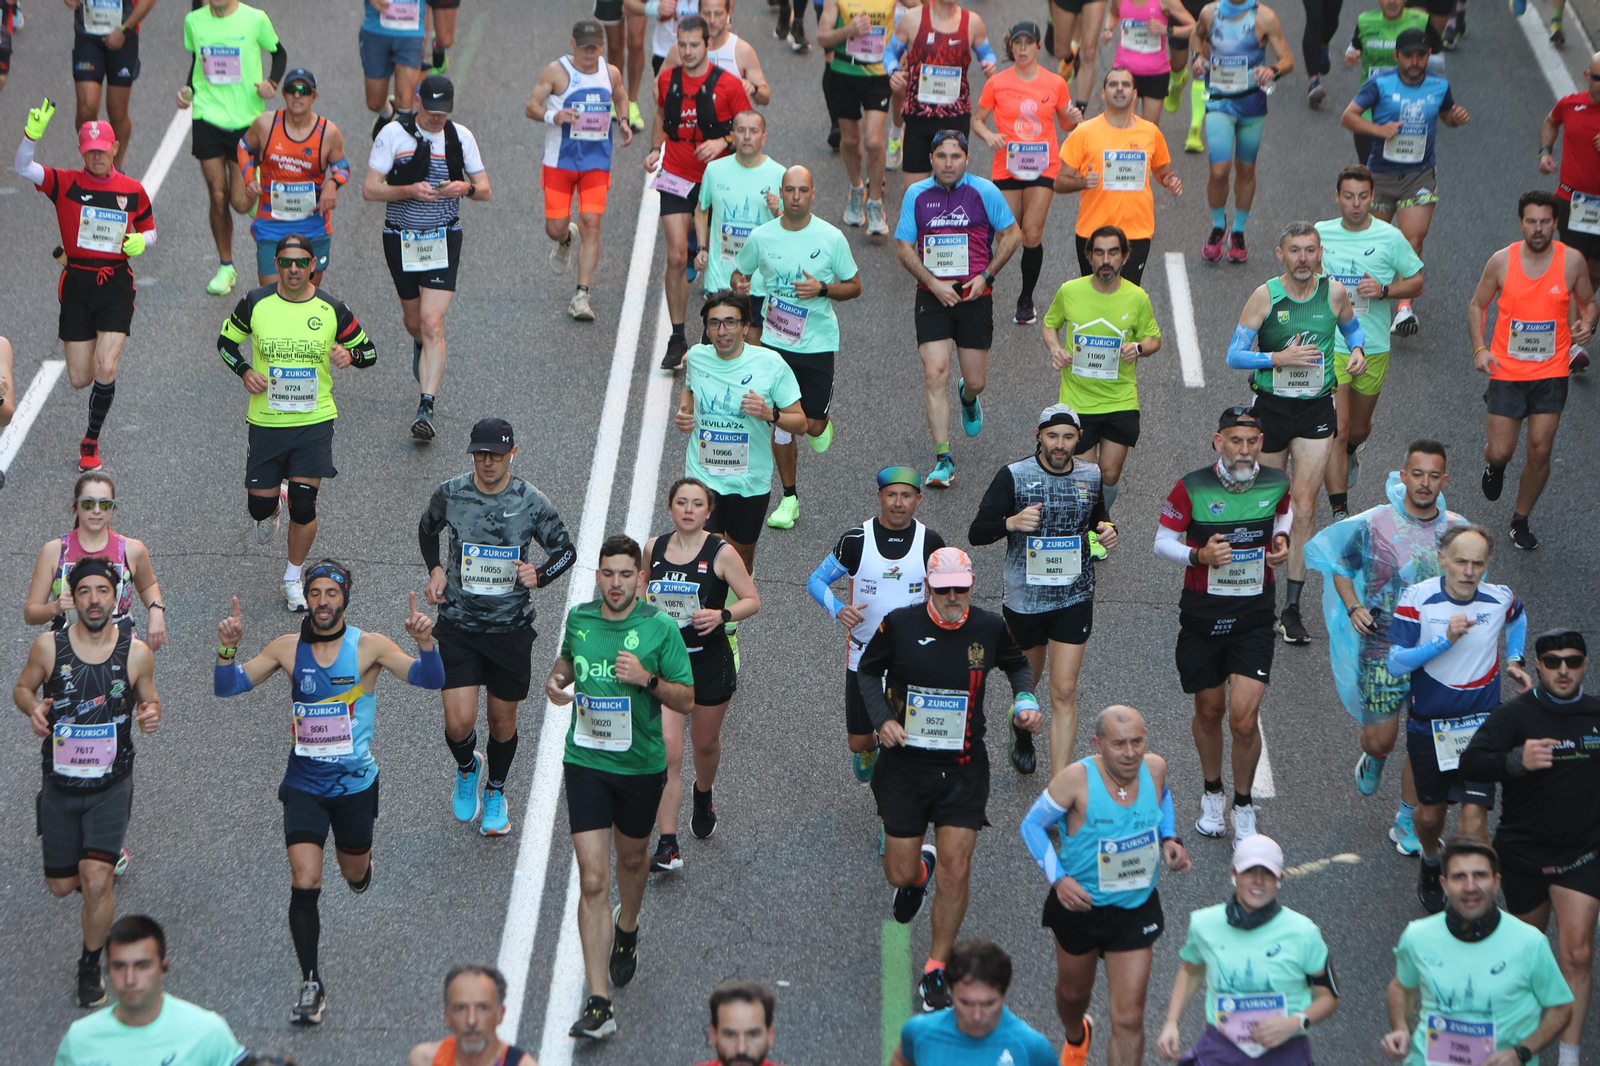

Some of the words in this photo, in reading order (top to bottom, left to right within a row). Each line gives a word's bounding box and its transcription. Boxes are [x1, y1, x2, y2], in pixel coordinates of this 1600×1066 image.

[269, 154, 313, 169] RUNNING
[98, 210, 123, 221] ZURICH
[417, 231, 440, 241] ZURICH
[937, 237, 962, 245] ZURICH
[416, 245, 433, 253] 10422
[779, 302, 803, 316] ZURICH
[776, 315, 789, 326] 7805
[1090, 339, 1115, 347] ZURICH
[275, 351, 293, 361] Night
[1087, 352, 1106, 361] 11069
[1289, 371, 1309, 379] 10057
[700, 419, 744, 430] SEVILLA'24
[714, 433, 744, 441] ZURICH
[712, 449, 732, 457] 10966
[704, 457, 741, 466] SALVATIERRA
[1046, 540, 1075, 548] ZURICH
[483, 549, 513, 558] ZURICH
[1231, 551, 1258, 561] ZURICH
[1046, 557, 1062, 565] 9481
[480, 565, 502, 574] 10055
[464, 575, 491, 583] ZAKARIA
[492, 576, 514, 584] BELHAJ
[1217, 577, 1257, 585] MANULOSETA
[664, 584, 691, 593] ZURICH
[664, 600, 684, 608] 10876
[1210, 629, 1231, 637] PORT
[77, 694, 106, 715] MRW
[591, 700, 622, 709] ZURICH
[928, 700, 959, 709] ZURICH
[308, 706, 341, 716] ZURICH
[590, 718, 612, 727] 10020
[926, 717, 945, 726] 9572
[75, 728, 108, 737] ZURICH
[310, 725, 329, 734] 8061
[591, 730, 612, 738] RUBEN
[920, 728, 948, 737] F.JAVIER
[75, 746, 95, 754] 7617
[70, 757, 100, 765] ALBERTO
[1120, 835, 1150, 851] ZURICH
[1239, 998, 1277, 1009] ZURICH
[1450, 1020, 1486, 1034] ZURICH
